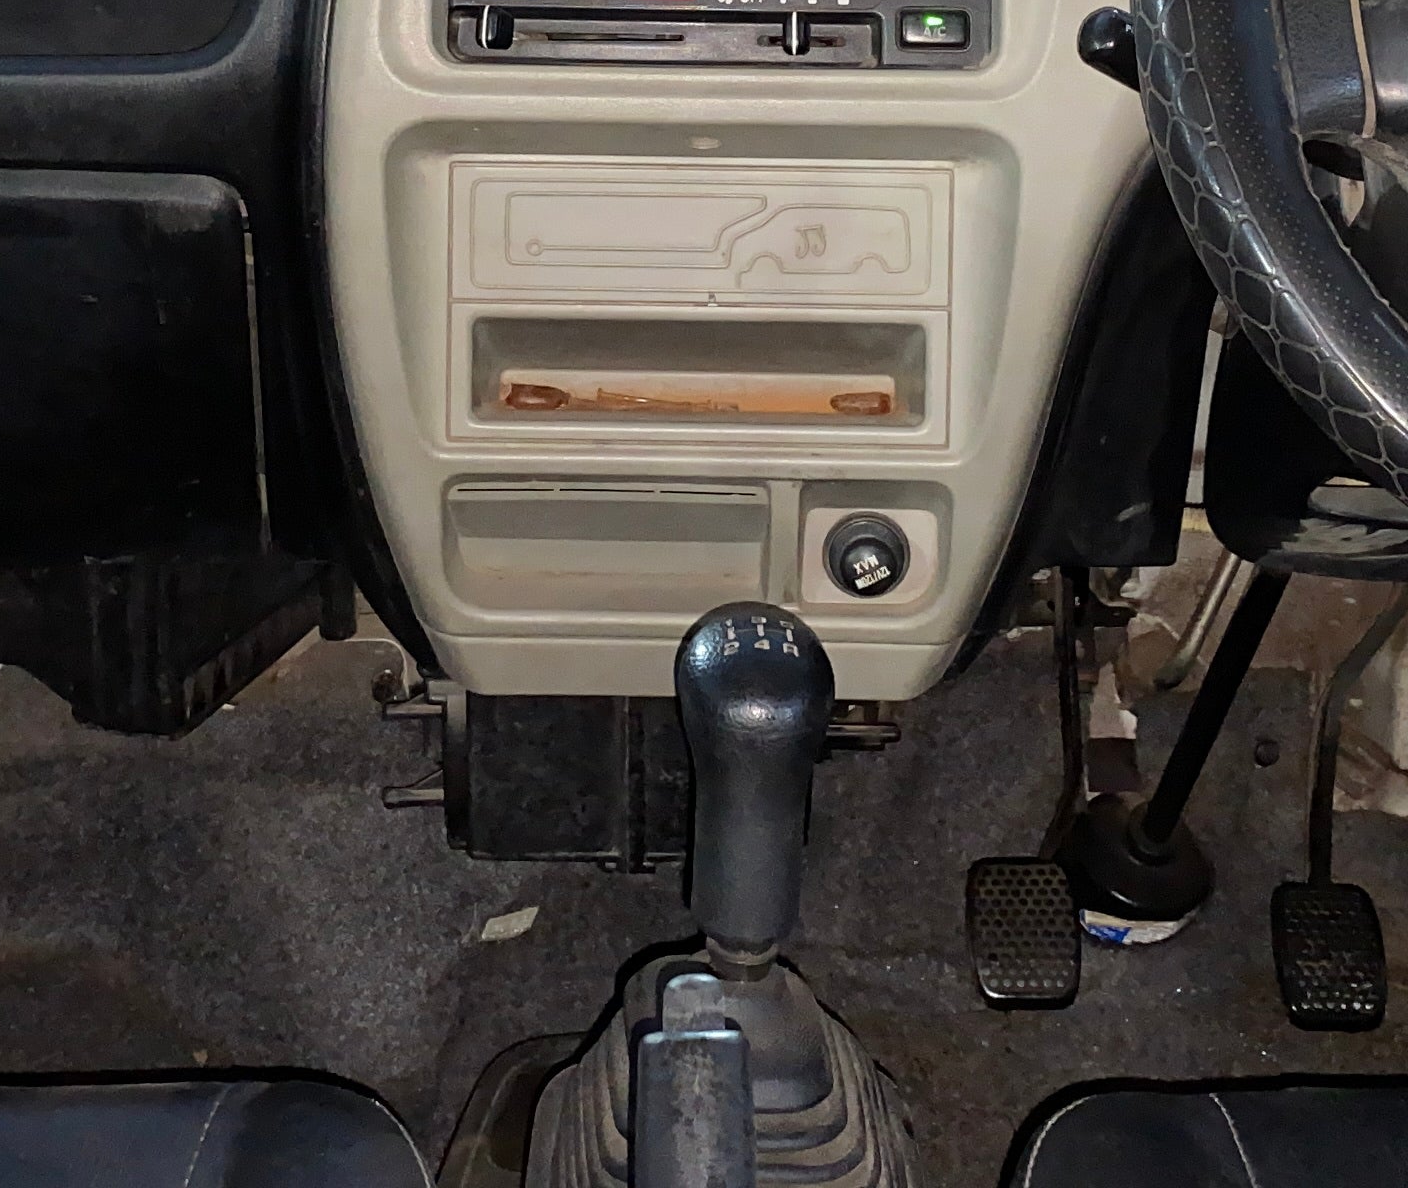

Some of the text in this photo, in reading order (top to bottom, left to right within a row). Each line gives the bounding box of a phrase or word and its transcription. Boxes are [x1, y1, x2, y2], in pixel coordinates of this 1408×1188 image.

[923, 26, 947, 37] A/C
[853, 554, 879, 575] MAX
[723, 639, 800, 657] 2 4 R
